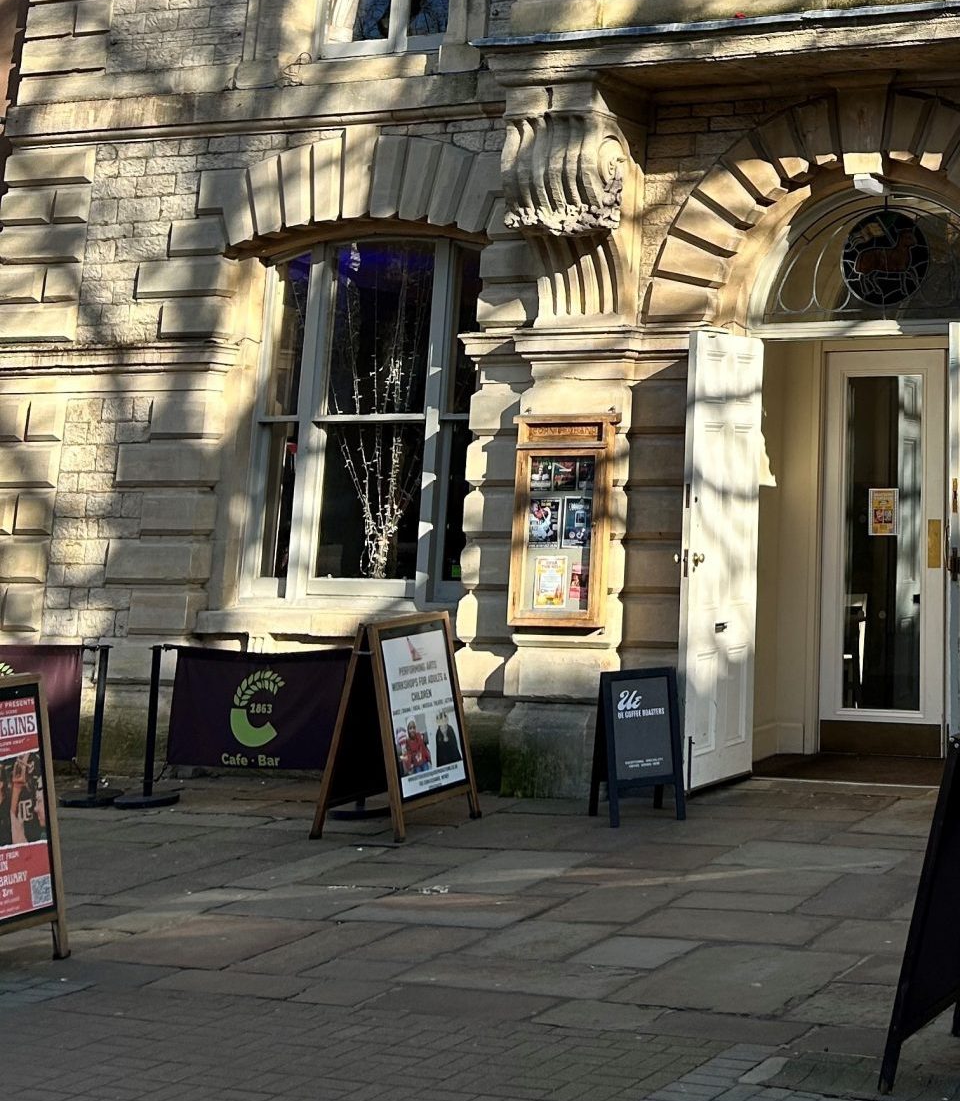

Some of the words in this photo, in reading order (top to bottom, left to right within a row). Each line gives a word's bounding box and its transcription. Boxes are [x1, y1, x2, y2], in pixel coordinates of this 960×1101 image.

[391, 680, 418, 692] WORKSHOPS
[418, 676, 427, 686] FOR
[411, 689, 432, 702] CHILDREN
[5, 698, 35, 709] PRESENTS
[250, 702, 273, 714] 1863
[625, 709, 641, 718] COFFEE
[642, 707, 665, 717] ROASTERS
[221, 753, 248, 766] Cafe
[258, 754, 281, 767] Bar
